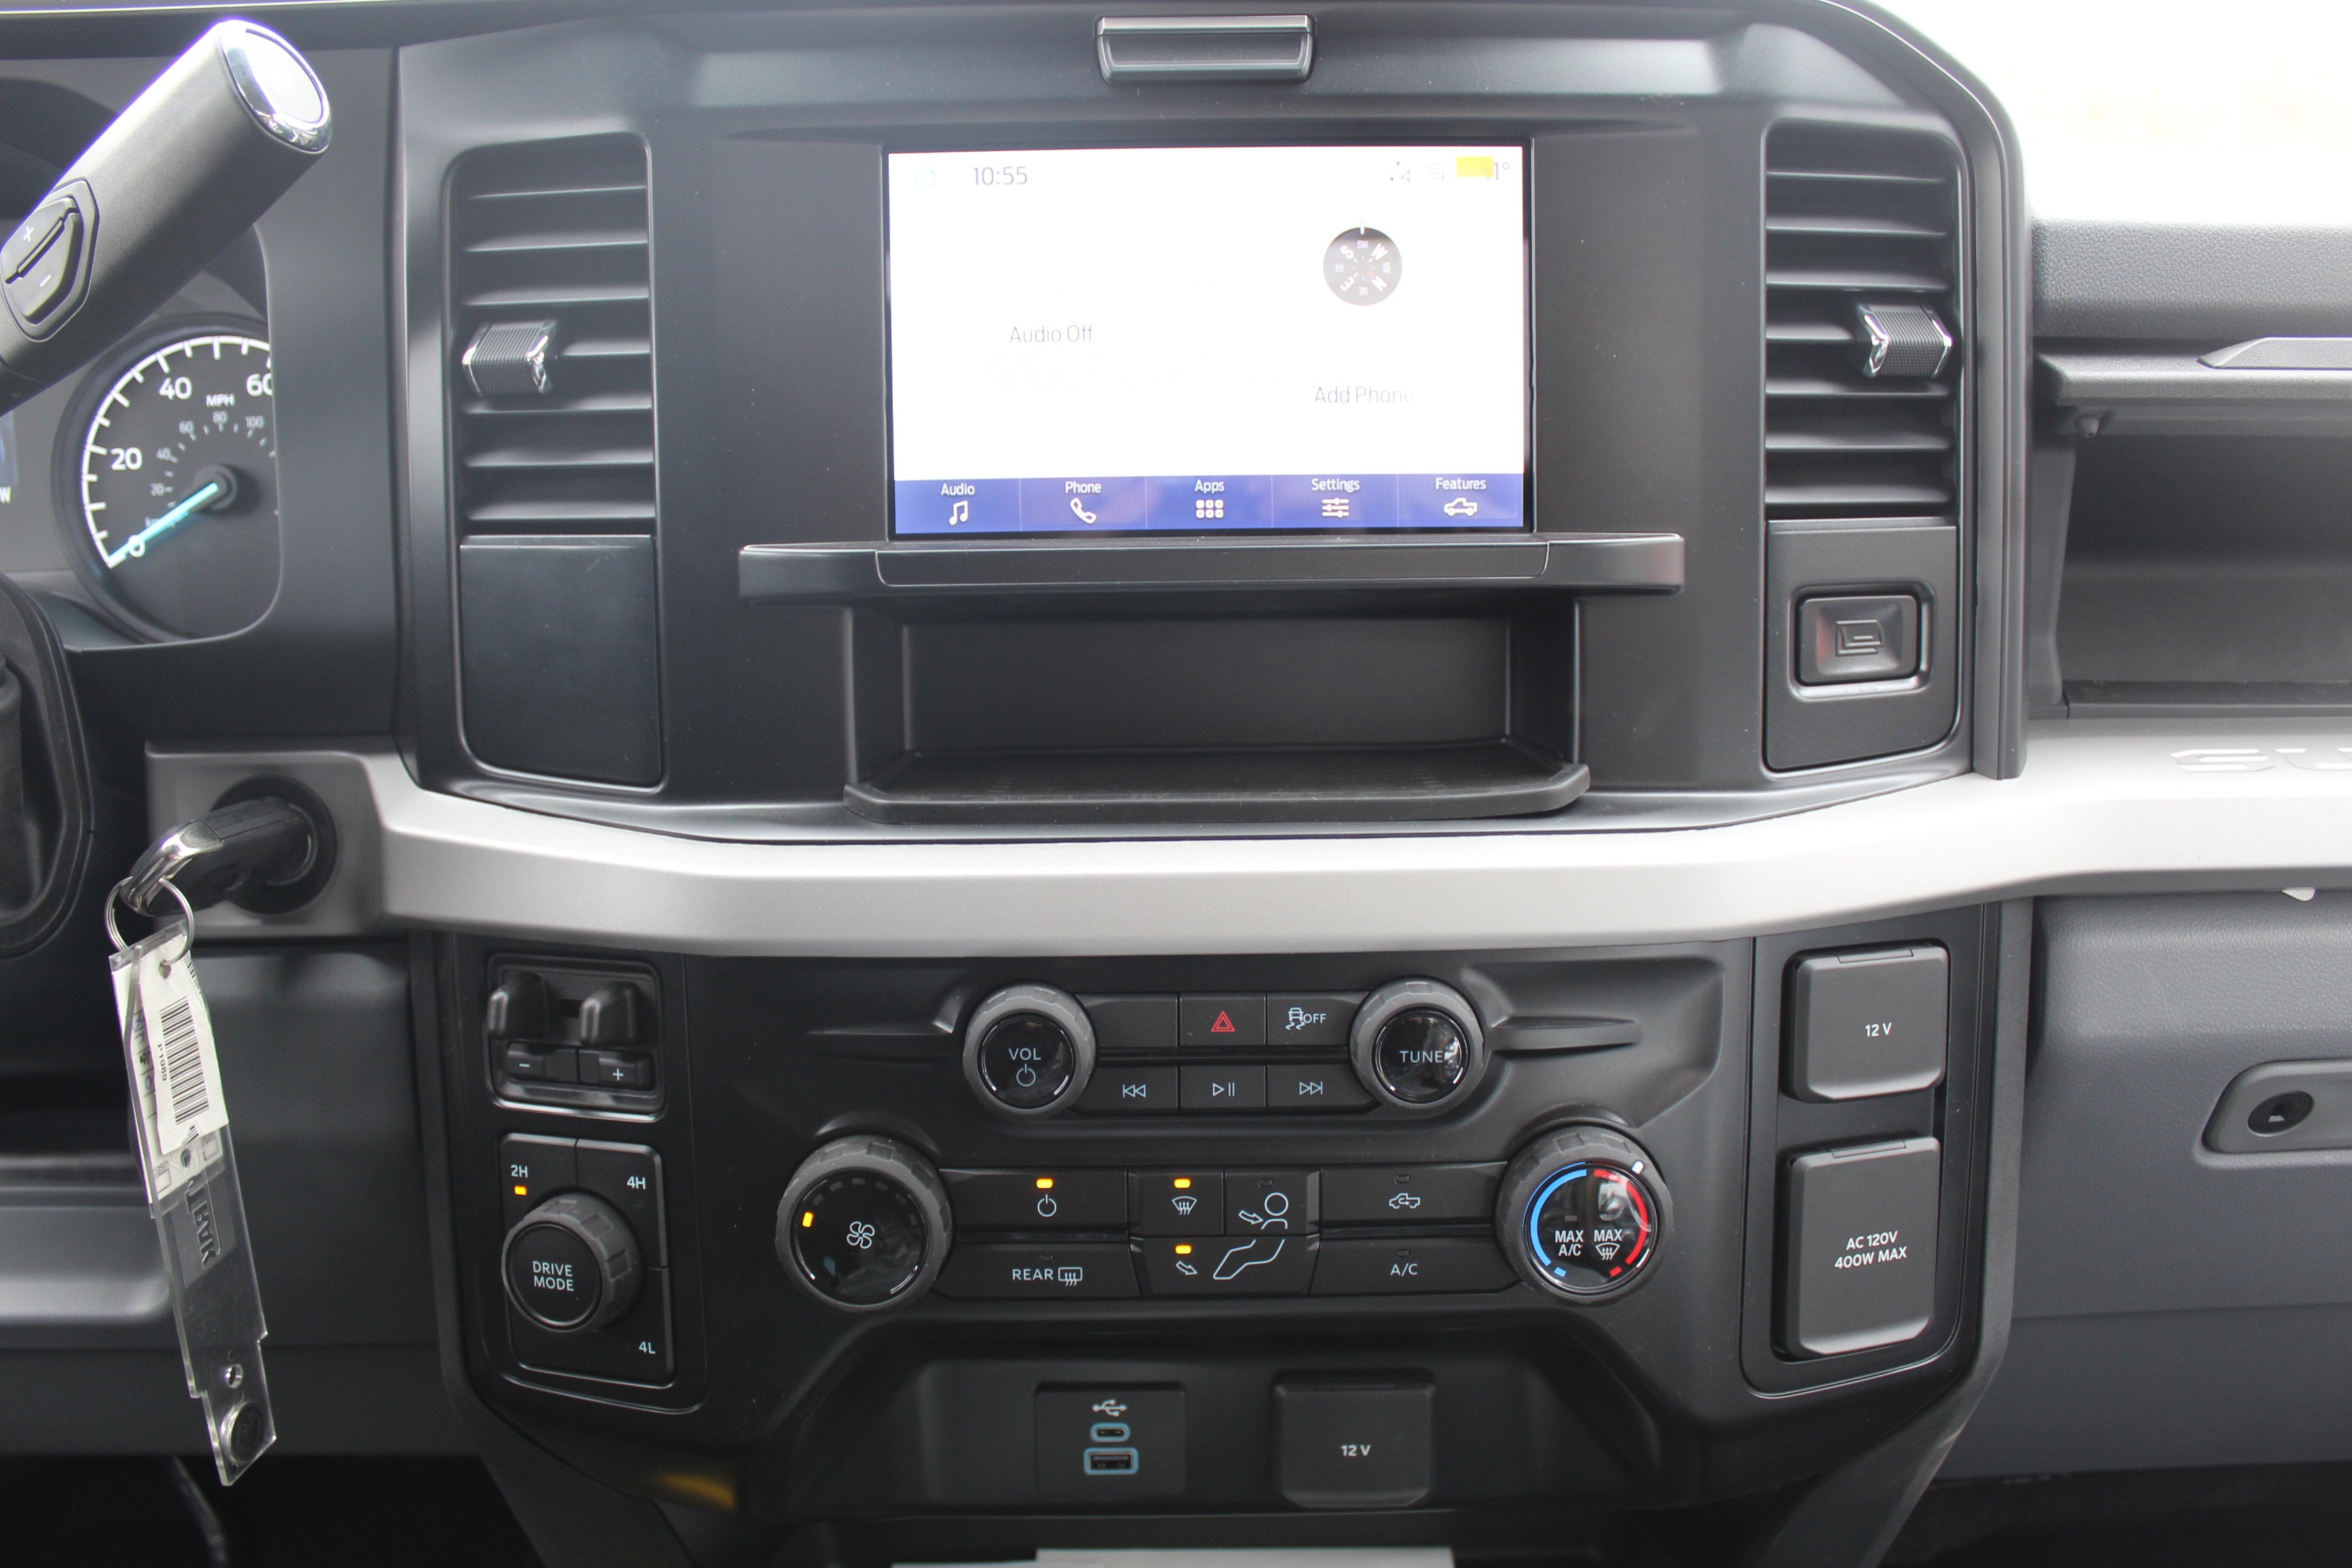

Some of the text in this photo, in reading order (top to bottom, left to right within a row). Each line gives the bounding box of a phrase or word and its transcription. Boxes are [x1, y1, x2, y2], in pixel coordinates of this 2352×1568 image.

[973, 166, 1028, 186] 10:55
[1339, 244, 1354, 260] S
[1356, 240, 1369, 249] SW
[1371, 242, 1389, 261] W
[1339, 276, 1355, 292] E
[1009, 324, 1094, 343] Audio Off
[159, 376, 193, 399] 40
[246, 373, 273, 397] 60
[206, 393, 235, 407] MPH
[1314, 386, 1350, 404] Add
[212, 410, 229, 425] 80
[245, 414, 265, 429] 100
[178, 420, 195, 435] 60
[110, 446, 144, 471] 20
[150, 482, 165, 497] 20
[941, 483, 976, 496] Audio
[1064, 480, 1102, 495] Phone
[1194, 479, 1225, 493] Apps
[1311, 478, 1360, 493] Settings
[1435, 477, 1486, 491] Features
[1303, 1011, 1326, 1025] OFF
[1865, 1022, 1893, 1037] 12 V
[1008, 1047, 1042, 1060] VOL
[1399, 1050, 1443, 1063] TUNE
[157, 1043, 168, 1082] P1989
[510, 1164, 529, 1178] 2H
[626, 1176, 646, 1190] 4H
[1554, 1230, 1584, 1243] MAX
[1593, 1228, 1622, 1242] MAX
[1846, 1230, 1899, 1251] AC 120V
[1558, 1243, 1582, 1257] A/C
[1834, 1245, 1908, 1269] 400W MAX
[532, 1260, 573, 1277] DRIVE
[1011, 1269, 1054, 1281] REAR
[1390, 1263, 1418, 1277] A/C
[534, 1275, 574, 1292] MODE
[638, 1341, 656, 1354] 4L
[1340, 1444, 1372, 1457] 12 V
